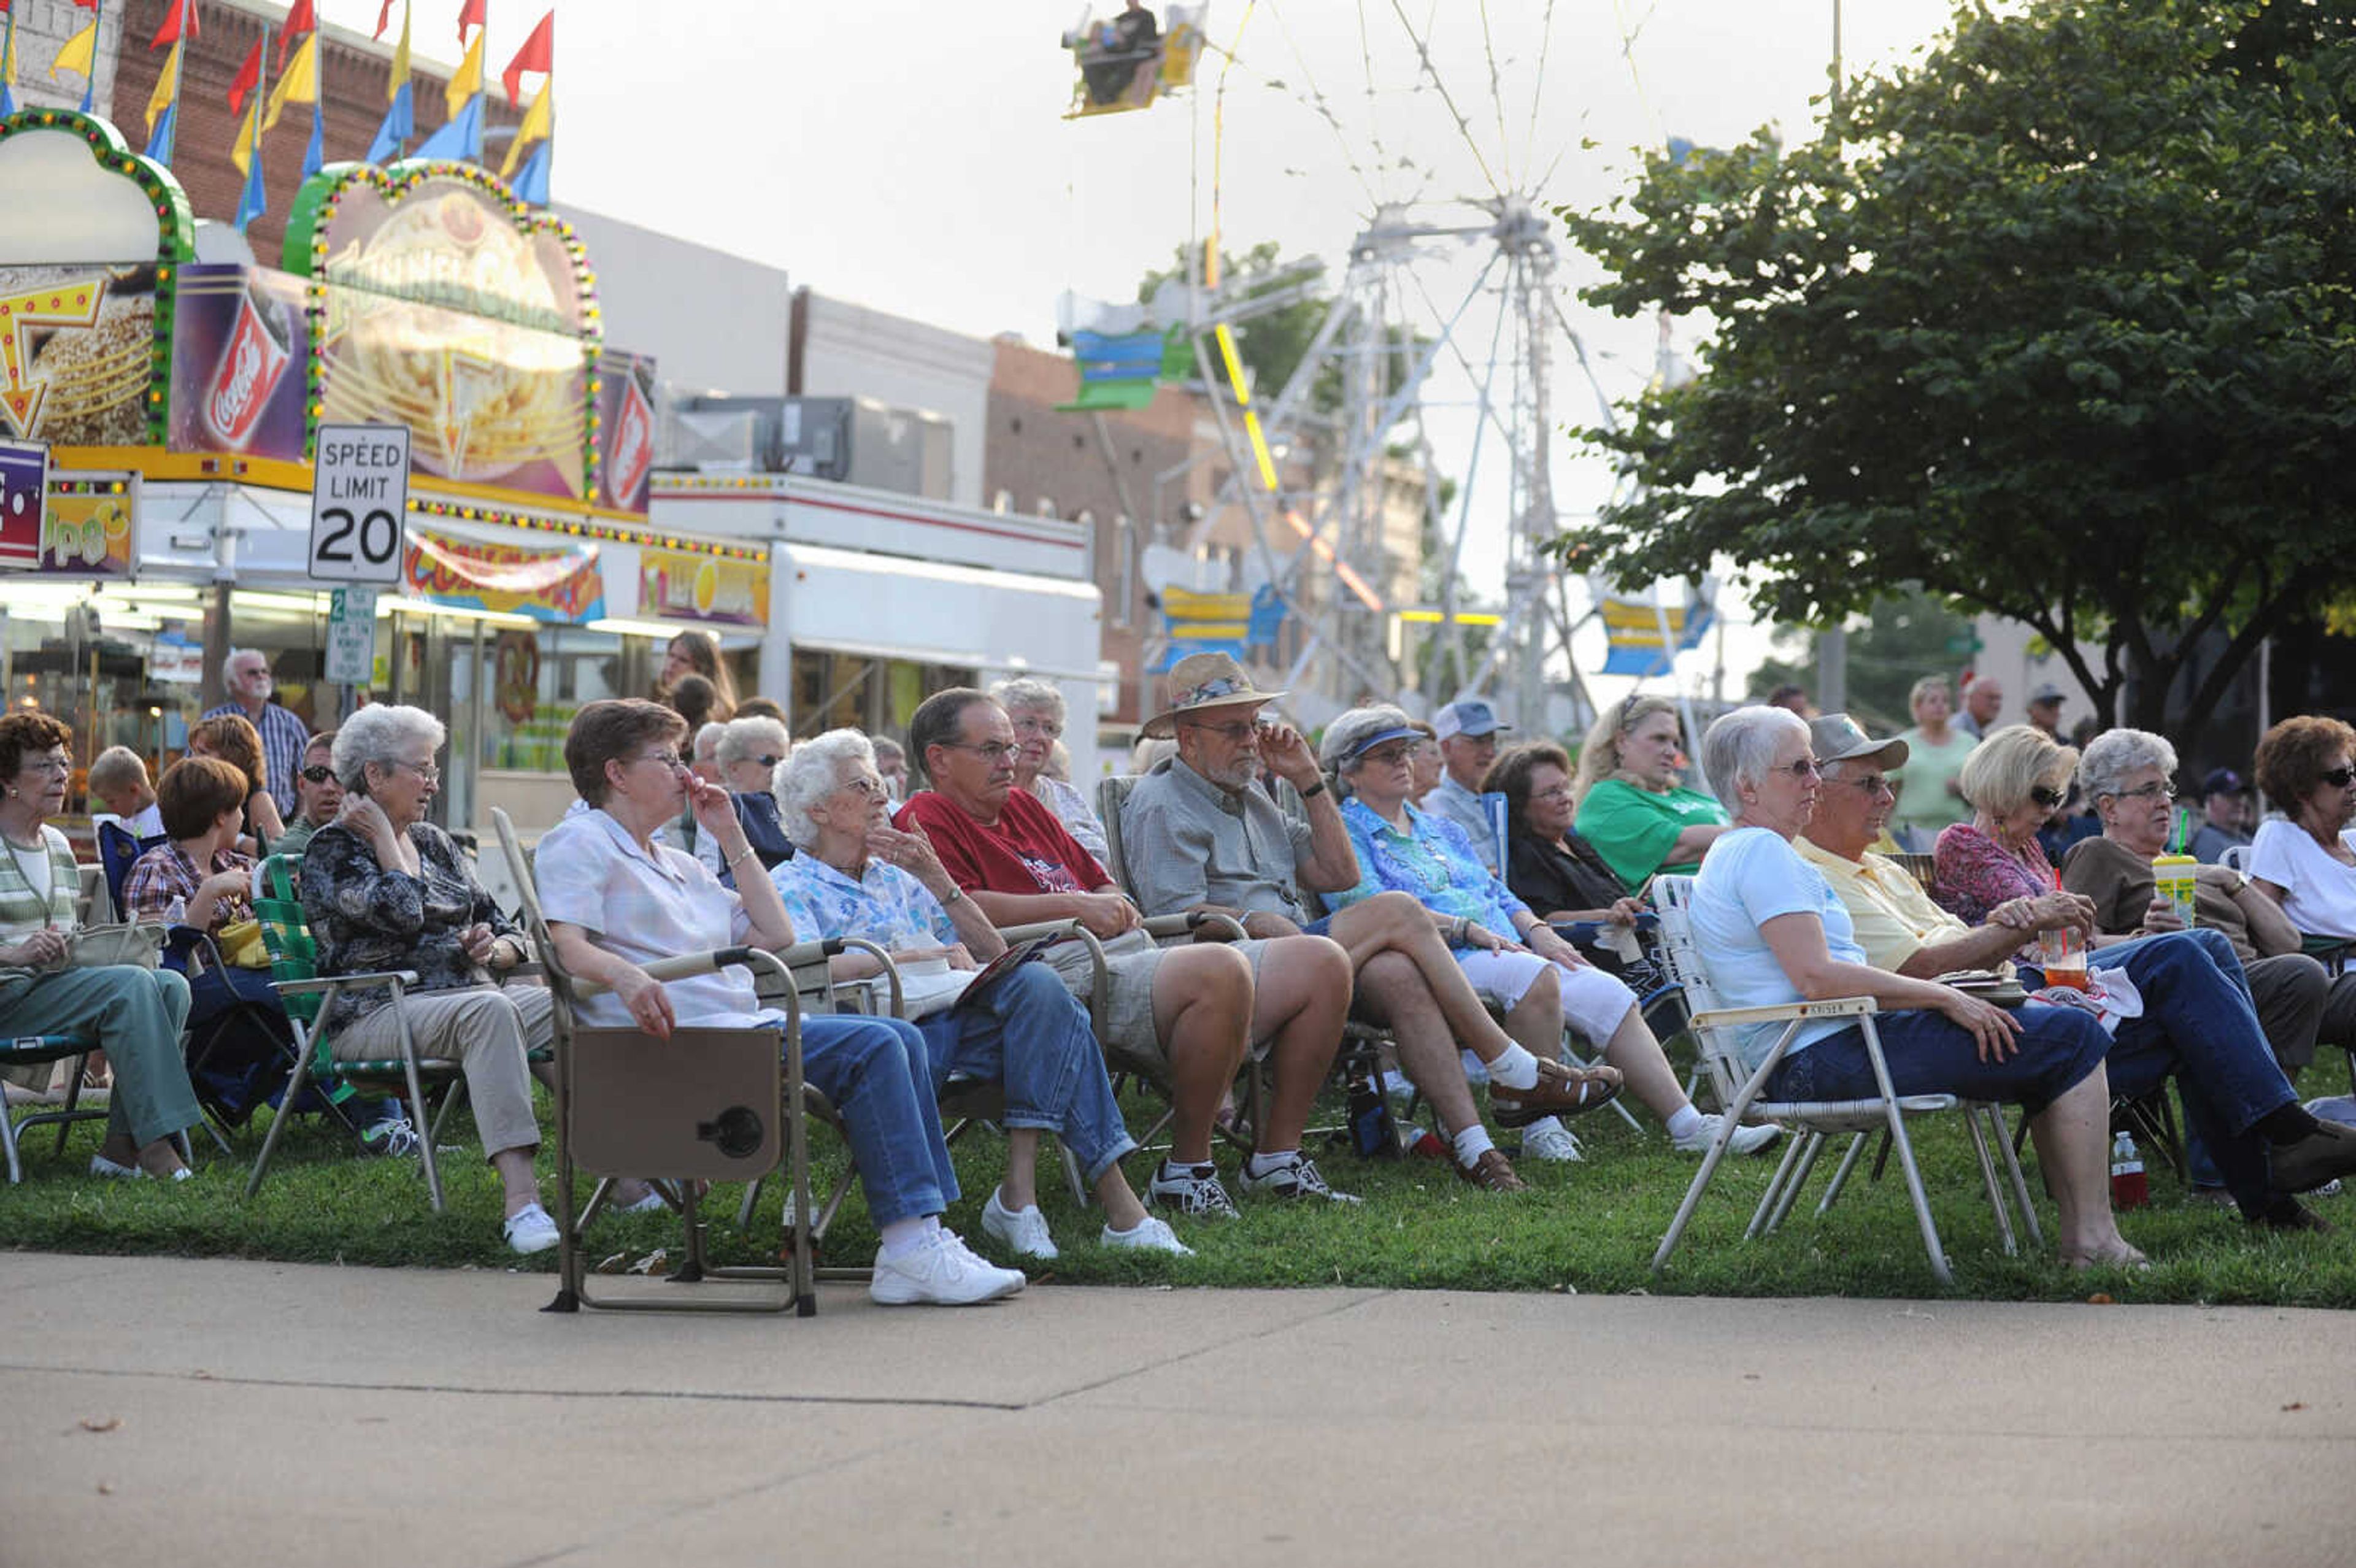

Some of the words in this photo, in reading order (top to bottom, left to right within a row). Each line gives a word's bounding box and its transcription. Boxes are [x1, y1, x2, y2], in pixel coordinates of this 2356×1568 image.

[325, 444, 400, 467] SPEED
[331, 476, 389, 499] LIMIT
[316, 507, 398, 564] 20
[334, 593, 343, 617] 2
